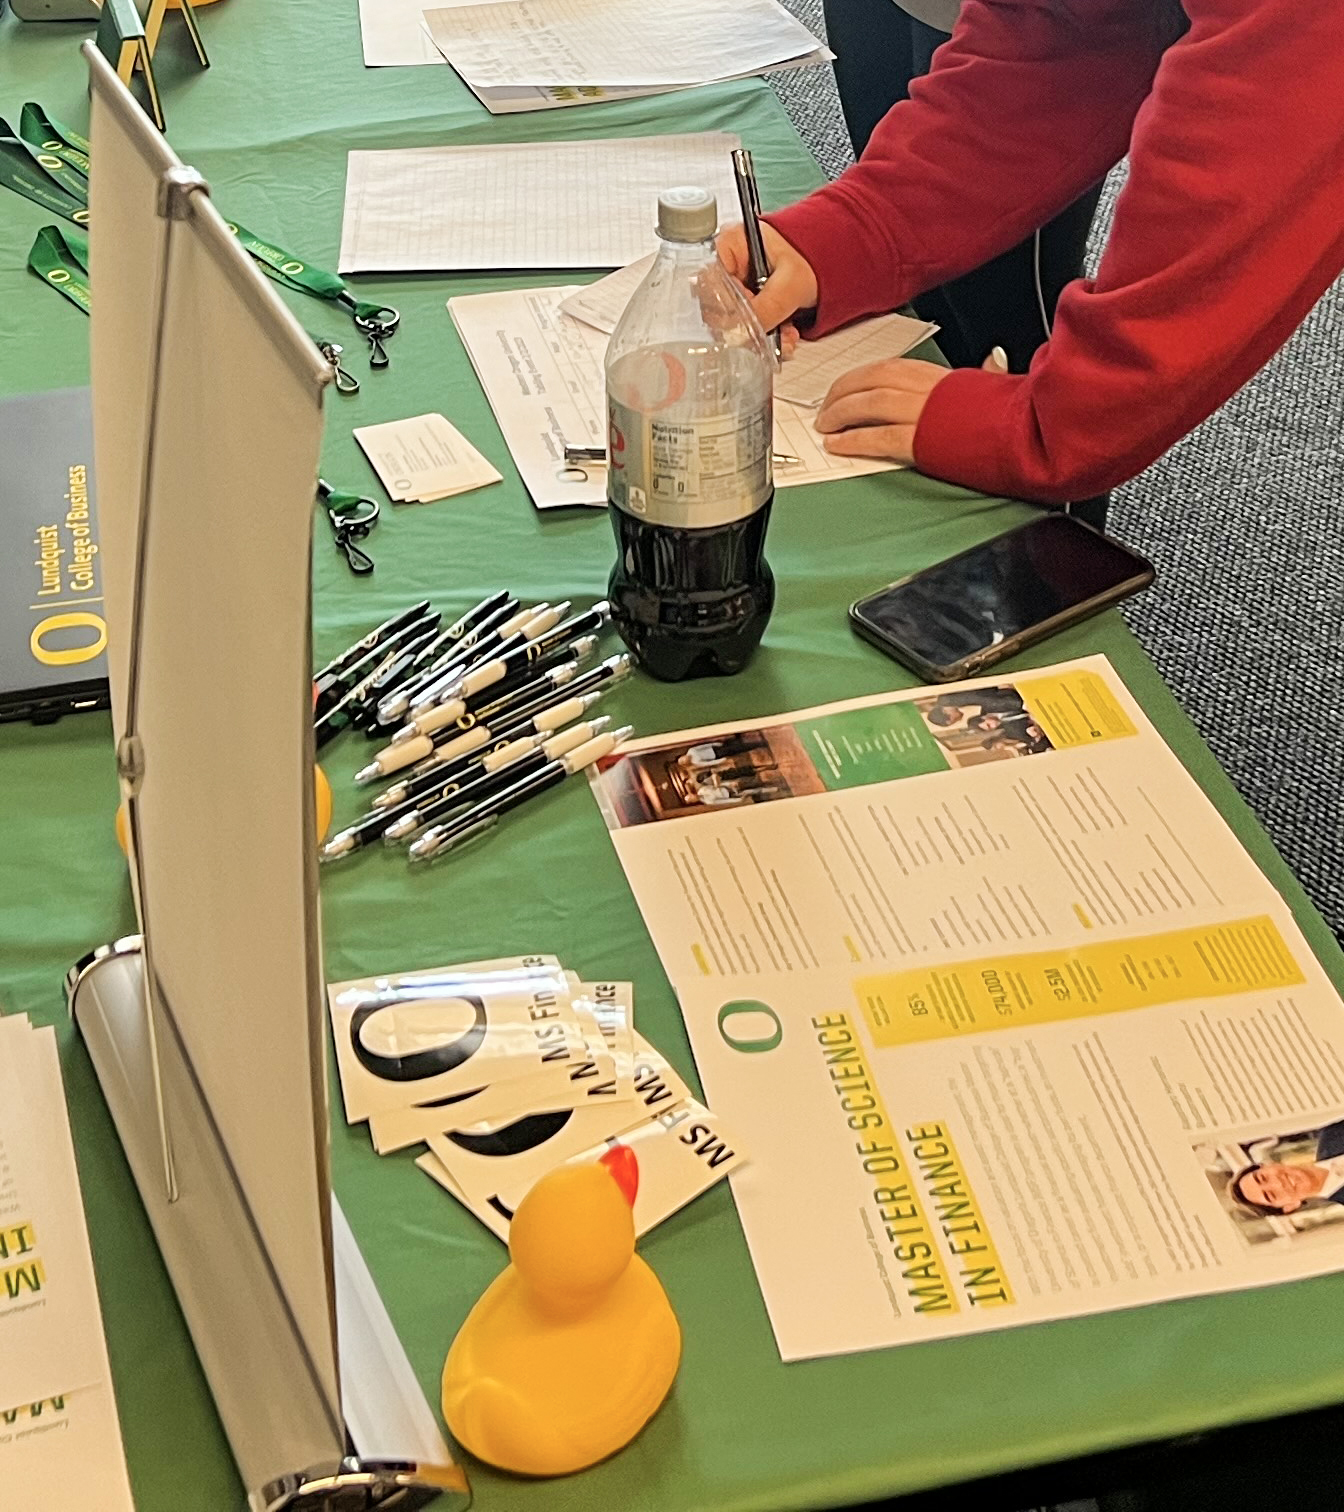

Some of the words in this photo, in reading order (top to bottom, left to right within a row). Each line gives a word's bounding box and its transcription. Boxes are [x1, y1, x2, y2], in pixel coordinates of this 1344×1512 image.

[652, 423, 695, 435] Nutrition
[652, 433, 678, 444] Facts
[64, 464, 90, 522] Business
[68, 518, 90, 538] of
[34, 525, 61, 596] Lundquist
[70, 538, 99, 593] College
[522, 955, 561, 1022] Fince
[907, 993, 929, 1016] 85%
[981, 969, 1013, 1016] $74,000
[1043, 967, 1071, 1001] $2.5M
[536, 1022, 572, 1064] MS
[810, 1012, 884, 1131] SCIENCE
[679, 1123, 735, 1170] MS
[856, 1140, 900, 1176] OF
[905, 1124, 989, 1255] FINANCE
[872, 1185, 954, 1314] MASTER
[958, 1266, 1009, 1307] IN
